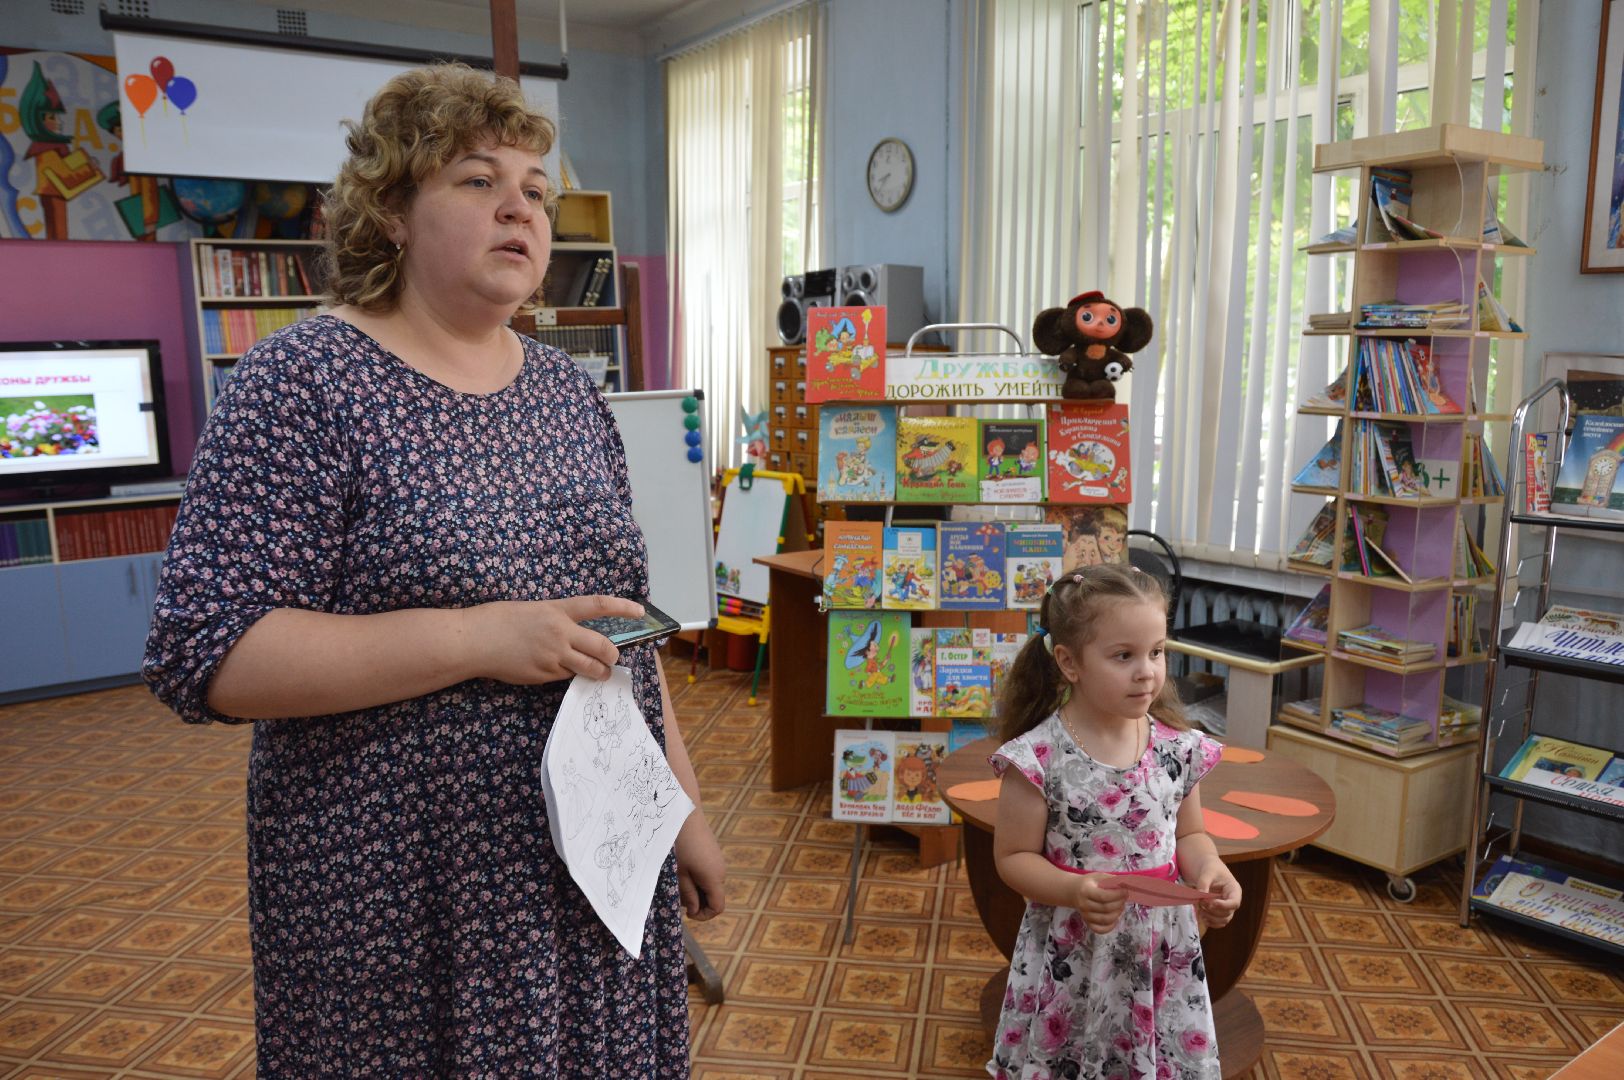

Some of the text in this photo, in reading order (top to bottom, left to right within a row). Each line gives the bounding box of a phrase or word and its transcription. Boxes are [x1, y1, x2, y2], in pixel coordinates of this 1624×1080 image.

[35, 374, 92, 386] ДРУЖБЫ
[885, 383, 984, 400] ДОРОЖИТЬ
[994, 380, 1064, 397] УМЕЙТЕ
